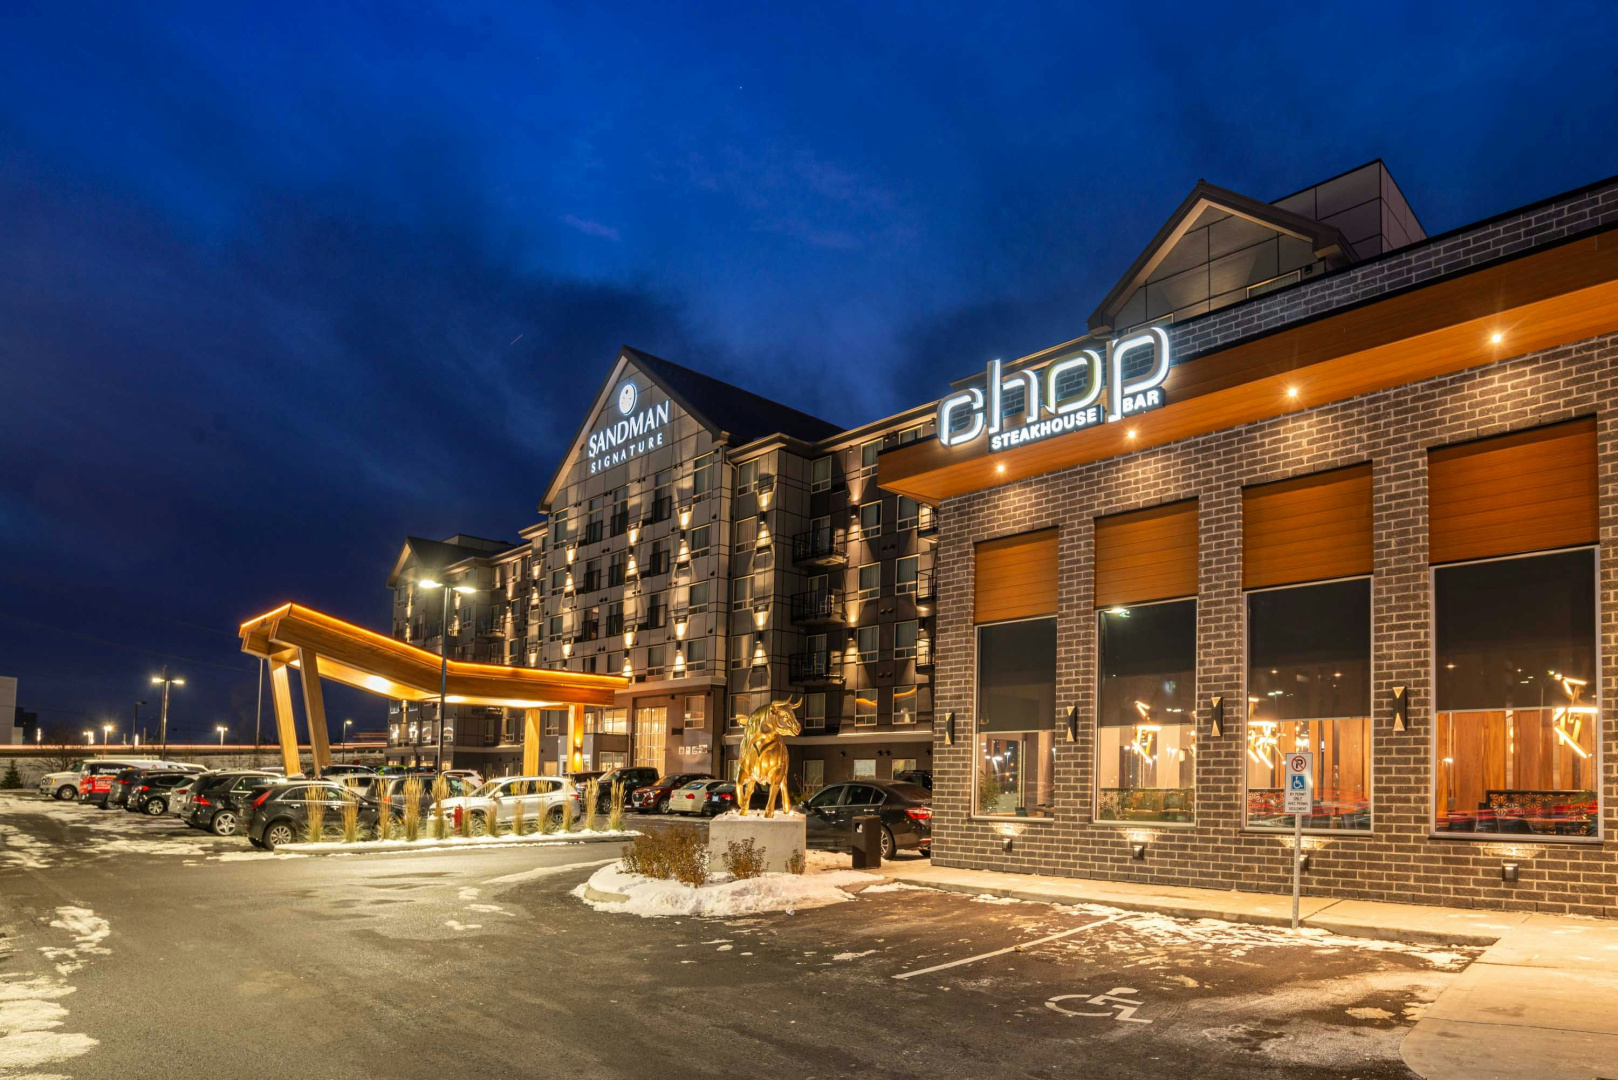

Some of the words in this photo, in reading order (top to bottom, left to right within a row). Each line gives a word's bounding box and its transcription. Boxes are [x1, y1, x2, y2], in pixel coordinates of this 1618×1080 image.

[936, 326, 1170, 446] chop
[1122, 389, 1160, 414] BAR
[588, 400, 669, 457] SANDMAN
[991, 406, 1098, 450] STEAKHOUSE
[590, 432, 664, 474] SIGNATURE
